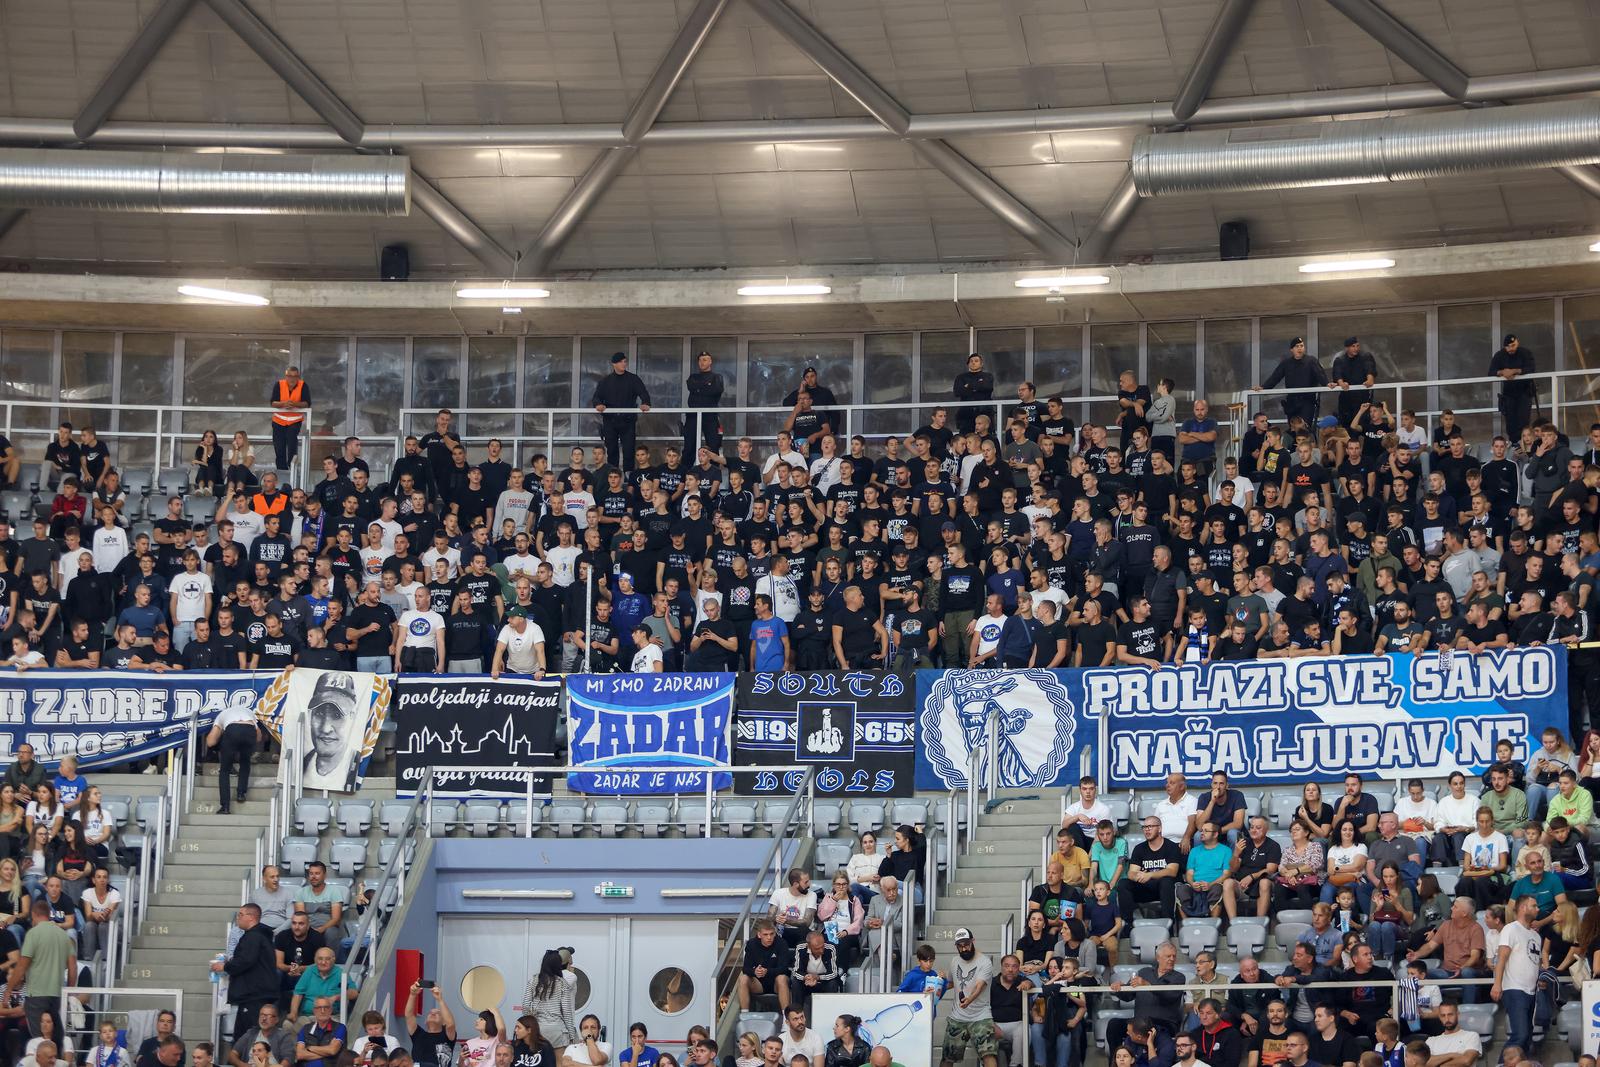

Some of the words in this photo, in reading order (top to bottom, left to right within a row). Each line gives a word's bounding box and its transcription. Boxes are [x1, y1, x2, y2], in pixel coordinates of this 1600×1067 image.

[586, 679, 604, 693] MI
[611, 678, 644, 694] SMO
[653, 676, 720, 692] ZADRANI
[751, 670, 905, 698] SOUTH
[957, 670, 1003, 686] TORNADO
[1086, 663, 1286, 715] PROLAZI
[1299, 659, 1403, 710] SVE,
[1414, 650, 1555, 702] SAMO
[32, 689, 167, 725] ZADRE
[399, 687, 490, 710] posljednji
[493, 690, 558, 711] sanjari
[570, 706, 729, 762] ZADAR
[753, 719, 789, 742] 19
[864, 720, 904, 742] 65
[1114, 719, 1247, 777] NAŠA
[1256, 718, 1448, 774] LJUBAV
[1458, 715, 1528, 765] NE
[593, 773, 640, 789] ZADAR
[648, 772, 667, 788] JE
